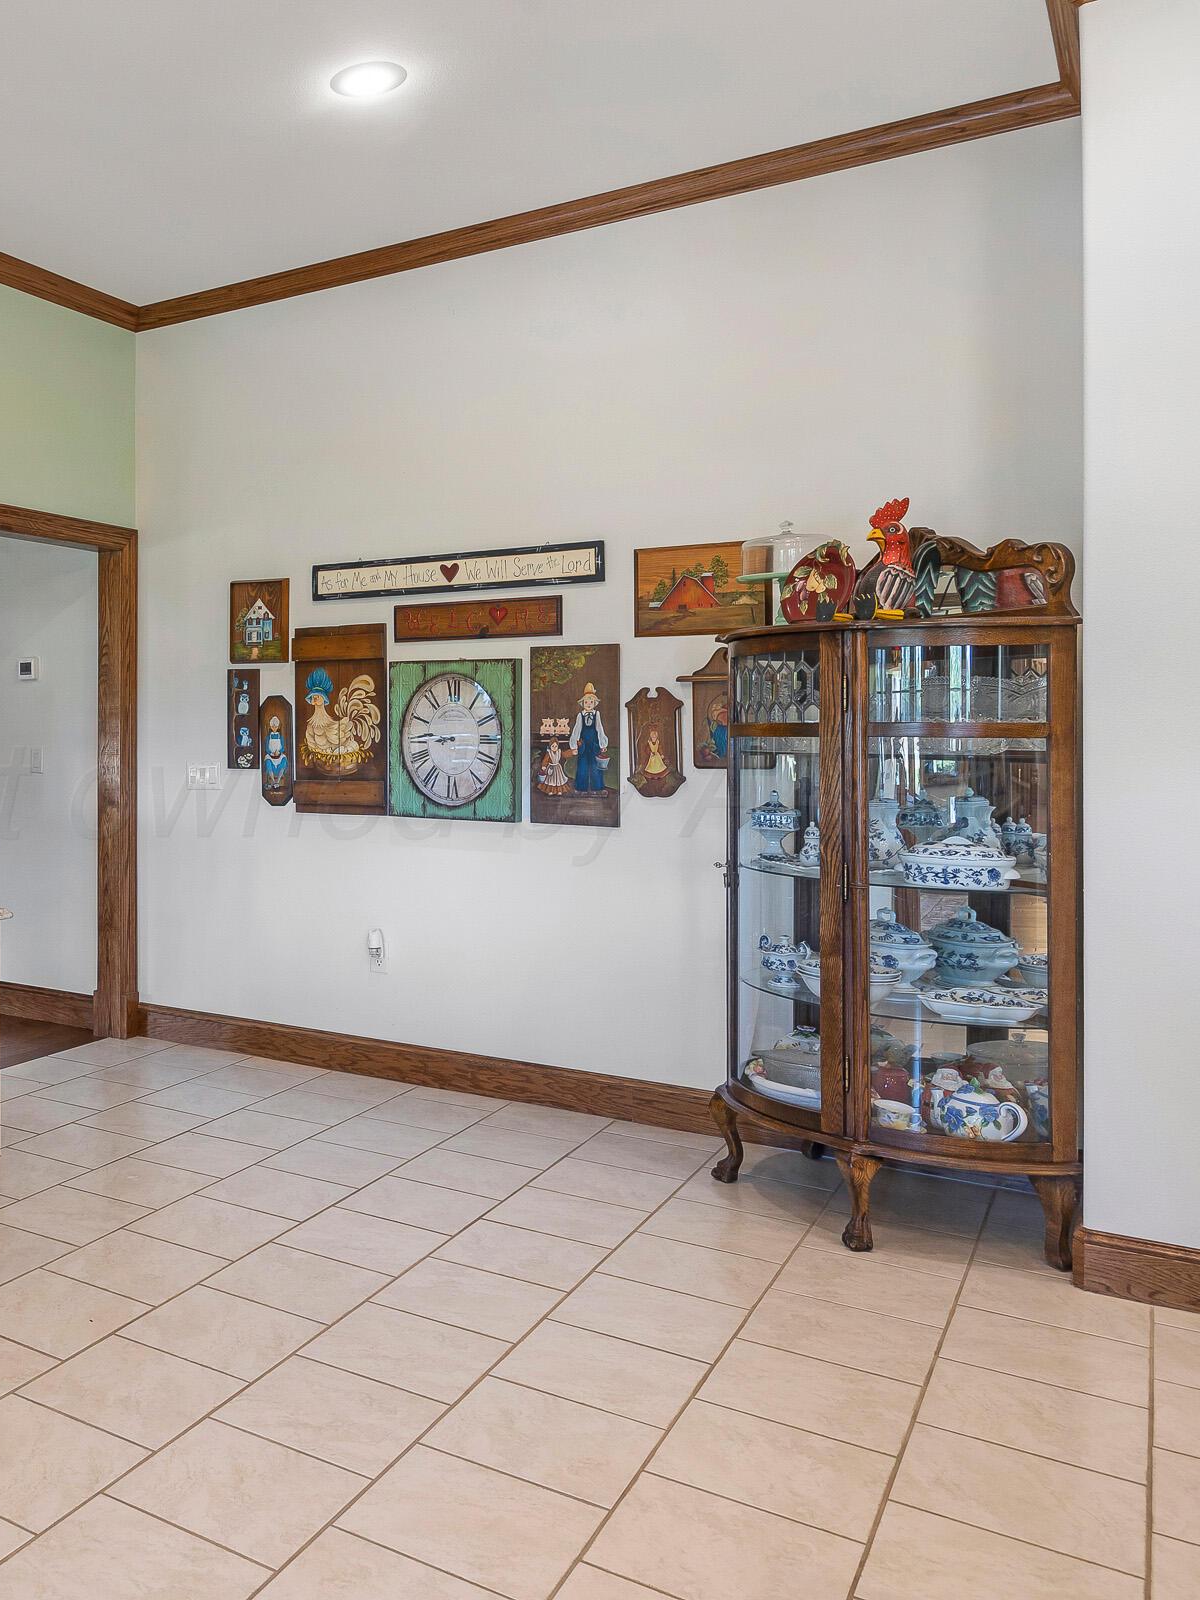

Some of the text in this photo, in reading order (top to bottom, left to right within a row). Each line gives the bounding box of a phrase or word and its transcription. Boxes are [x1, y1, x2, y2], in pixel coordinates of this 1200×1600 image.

[335, 571, 349, 591] for
[351, 571, 368, 591] Me
[402, 564, 439, 585] House
[464, 560, 482, 581] We
[485, 559, 508, 579] Will
[512, 556, 544, 578] Serve
[561, 551, 593, 574] Lord
